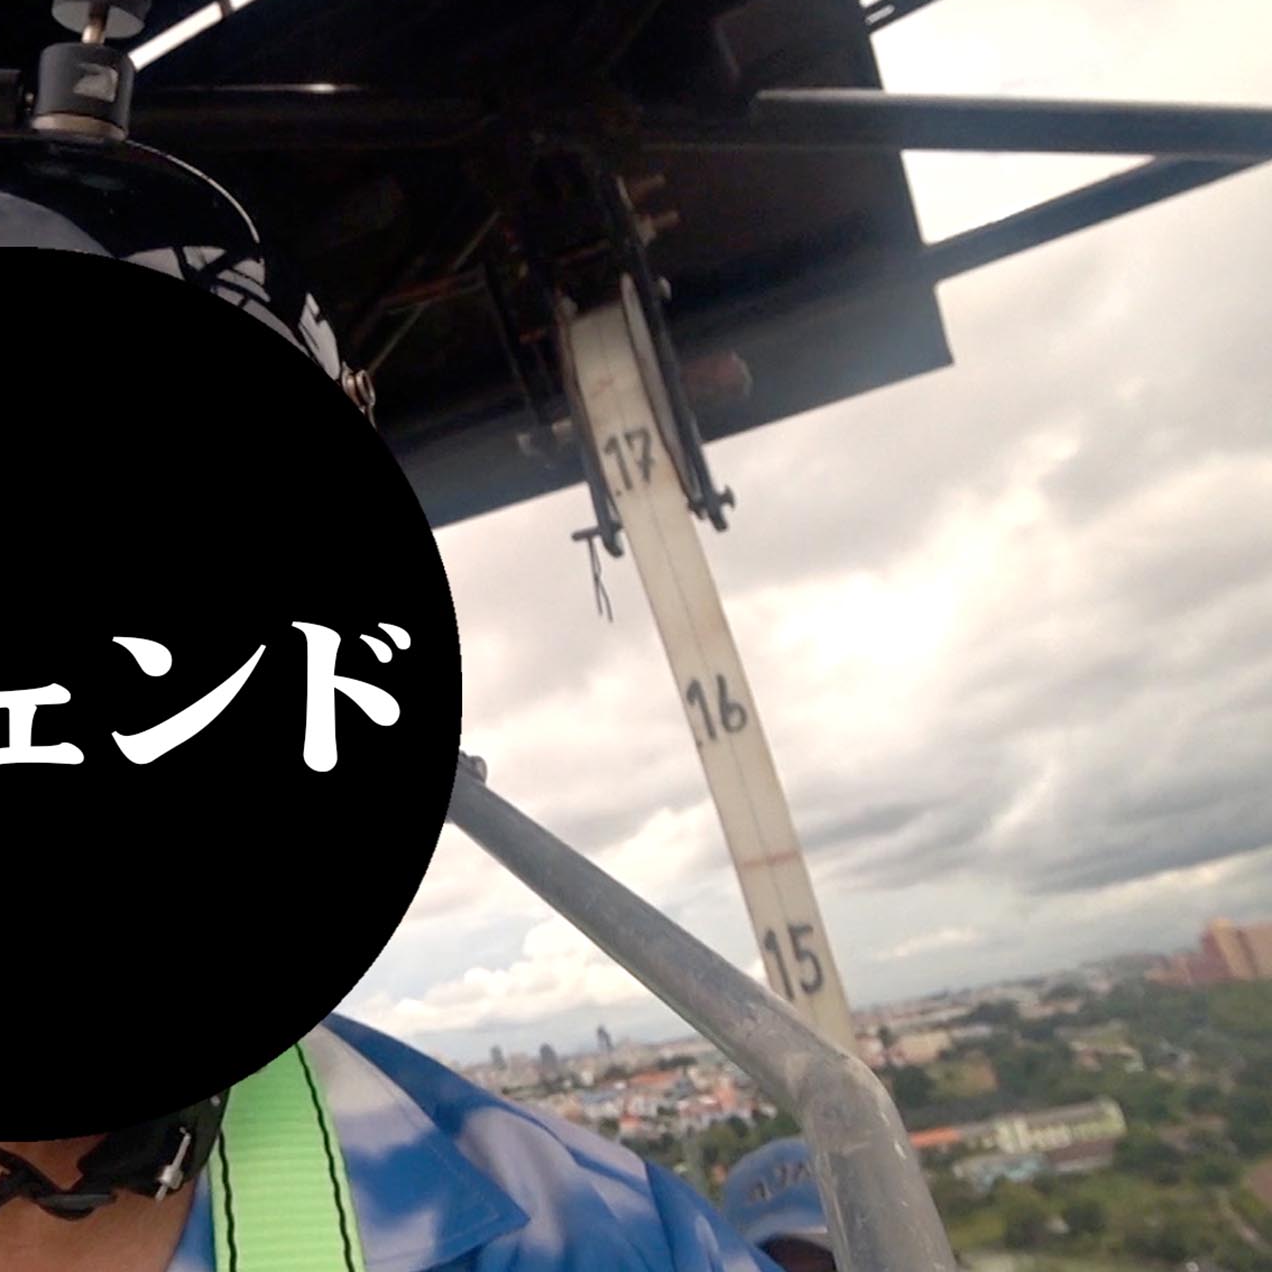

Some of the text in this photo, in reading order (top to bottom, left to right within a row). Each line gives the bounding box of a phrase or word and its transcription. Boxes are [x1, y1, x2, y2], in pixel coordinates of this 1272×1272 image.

[605, 427, 655, 491] 17
[686, 674, 748, 741] 16
[764, 924, 823, 1002] 15
